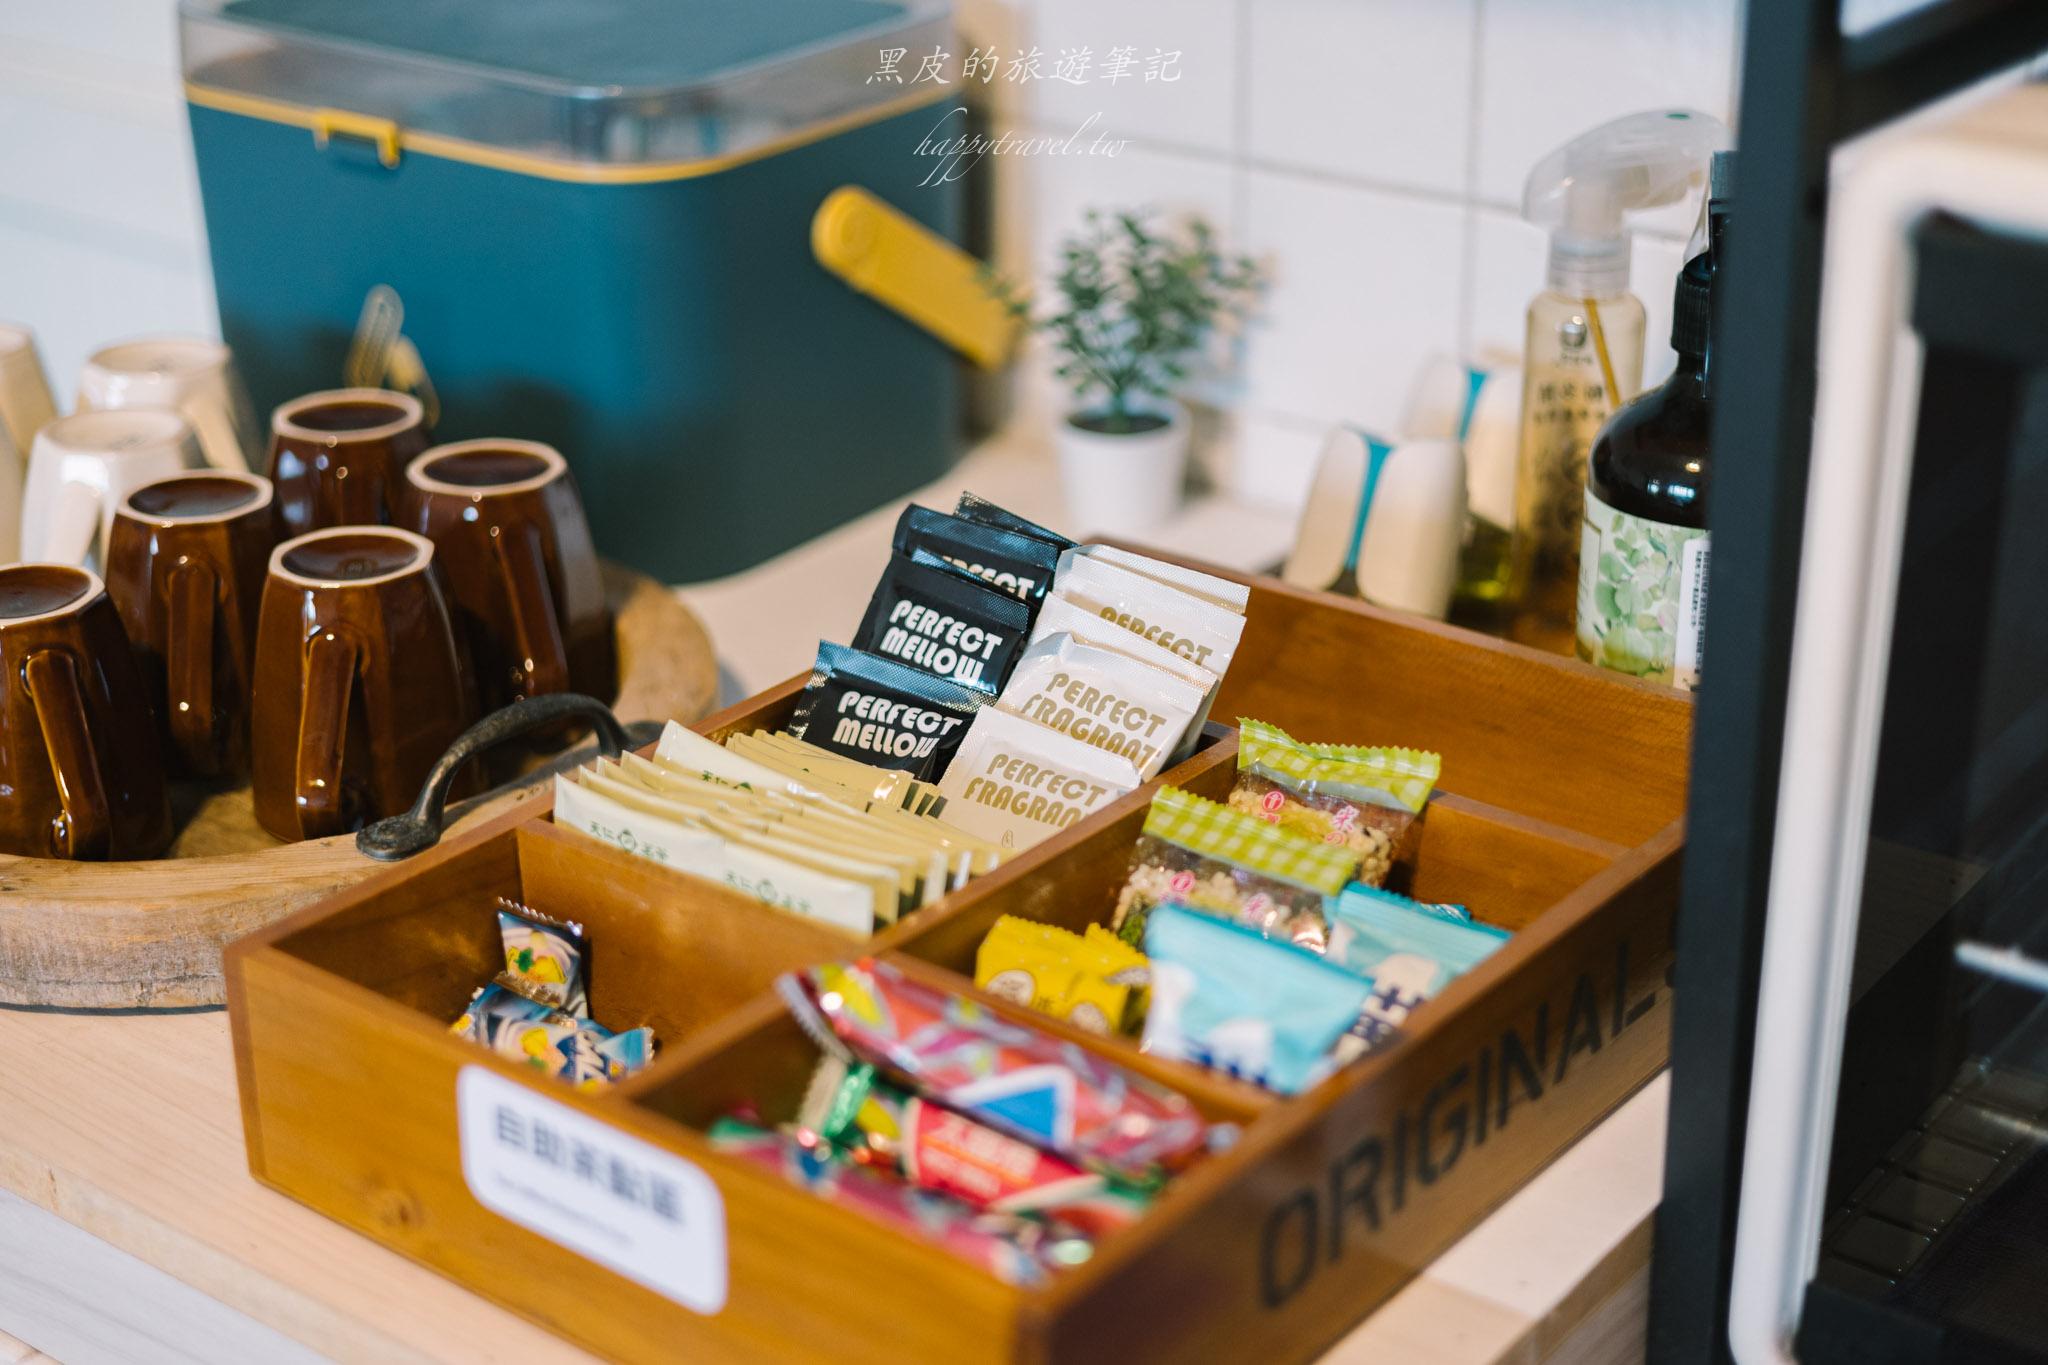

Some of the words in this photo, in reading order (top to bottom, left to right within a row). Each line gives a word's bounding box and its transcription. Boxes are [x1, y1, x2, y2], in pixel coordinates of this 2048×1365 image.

[880, 626, 984, 685] MELLOW
[889, 600, 1003, 660] PERFECT
[838, 691, 963, 735] PERFECT
[1046, 672, 1167, 738] PERFECT
[832, 717, 940, 758] MELLOW
[963, 777, 1084, 828] FRAGRAN
[986, 753, 1107, 807] PERFECT
